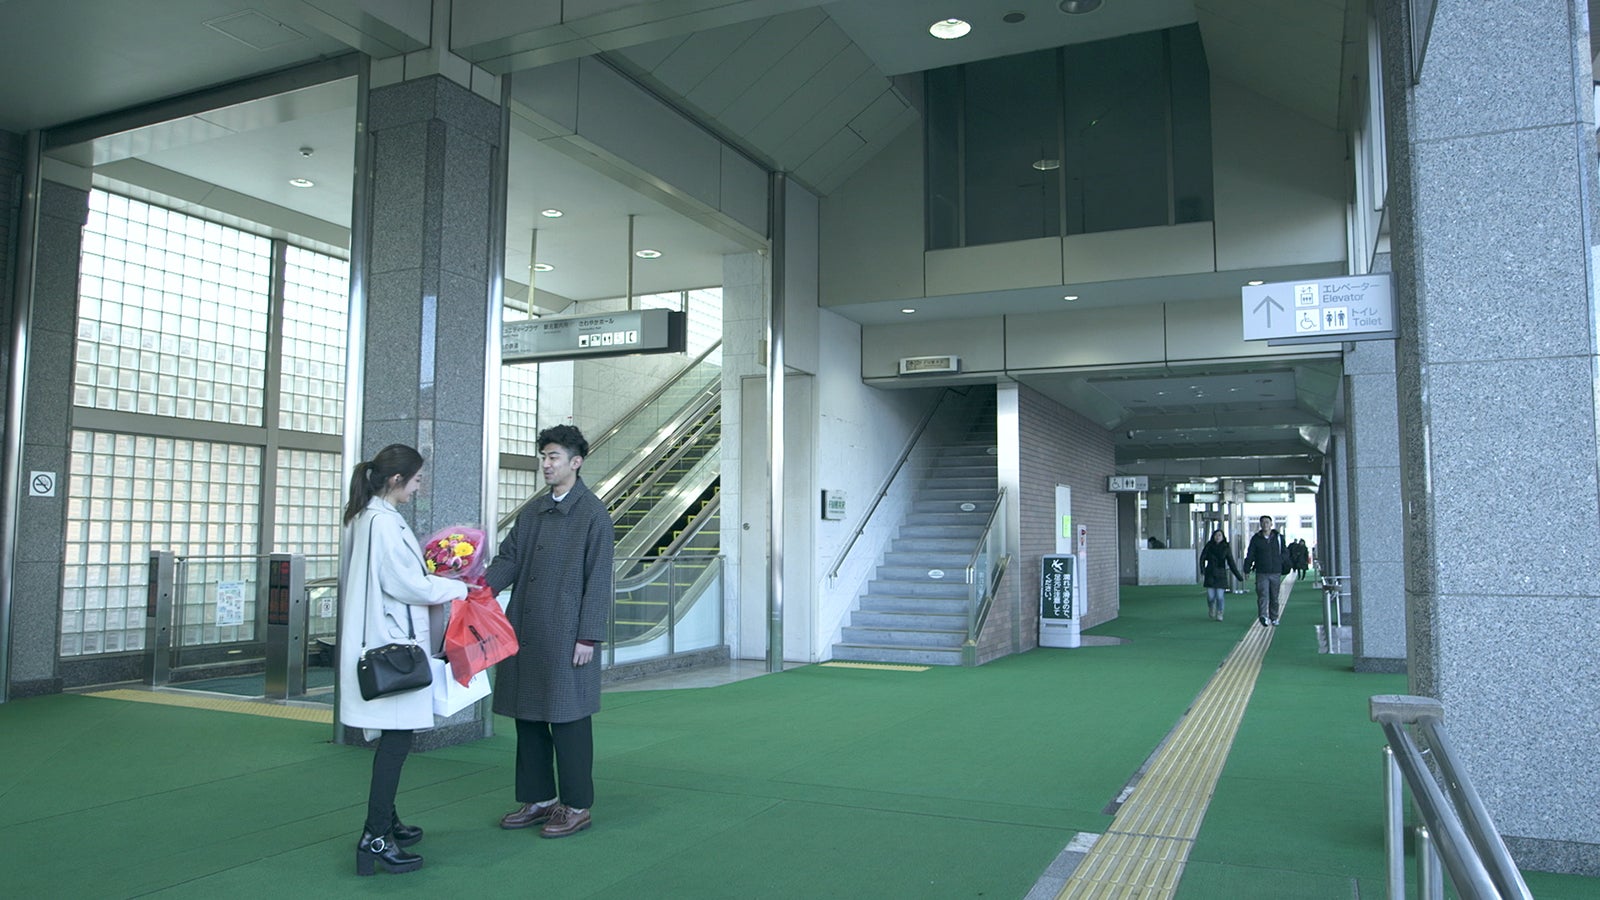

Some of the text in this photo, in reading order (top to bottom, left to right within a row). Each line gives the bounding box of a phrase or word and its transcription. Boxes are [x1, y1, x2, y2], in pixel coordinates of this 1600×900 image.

[1322, 282, 1380, 293] エレベーター
[1322, 293, 1365, 303] Elevator
[1351, 307, 1378, 317] トイレ
[1353, 317, 1383, 327] Toilet
